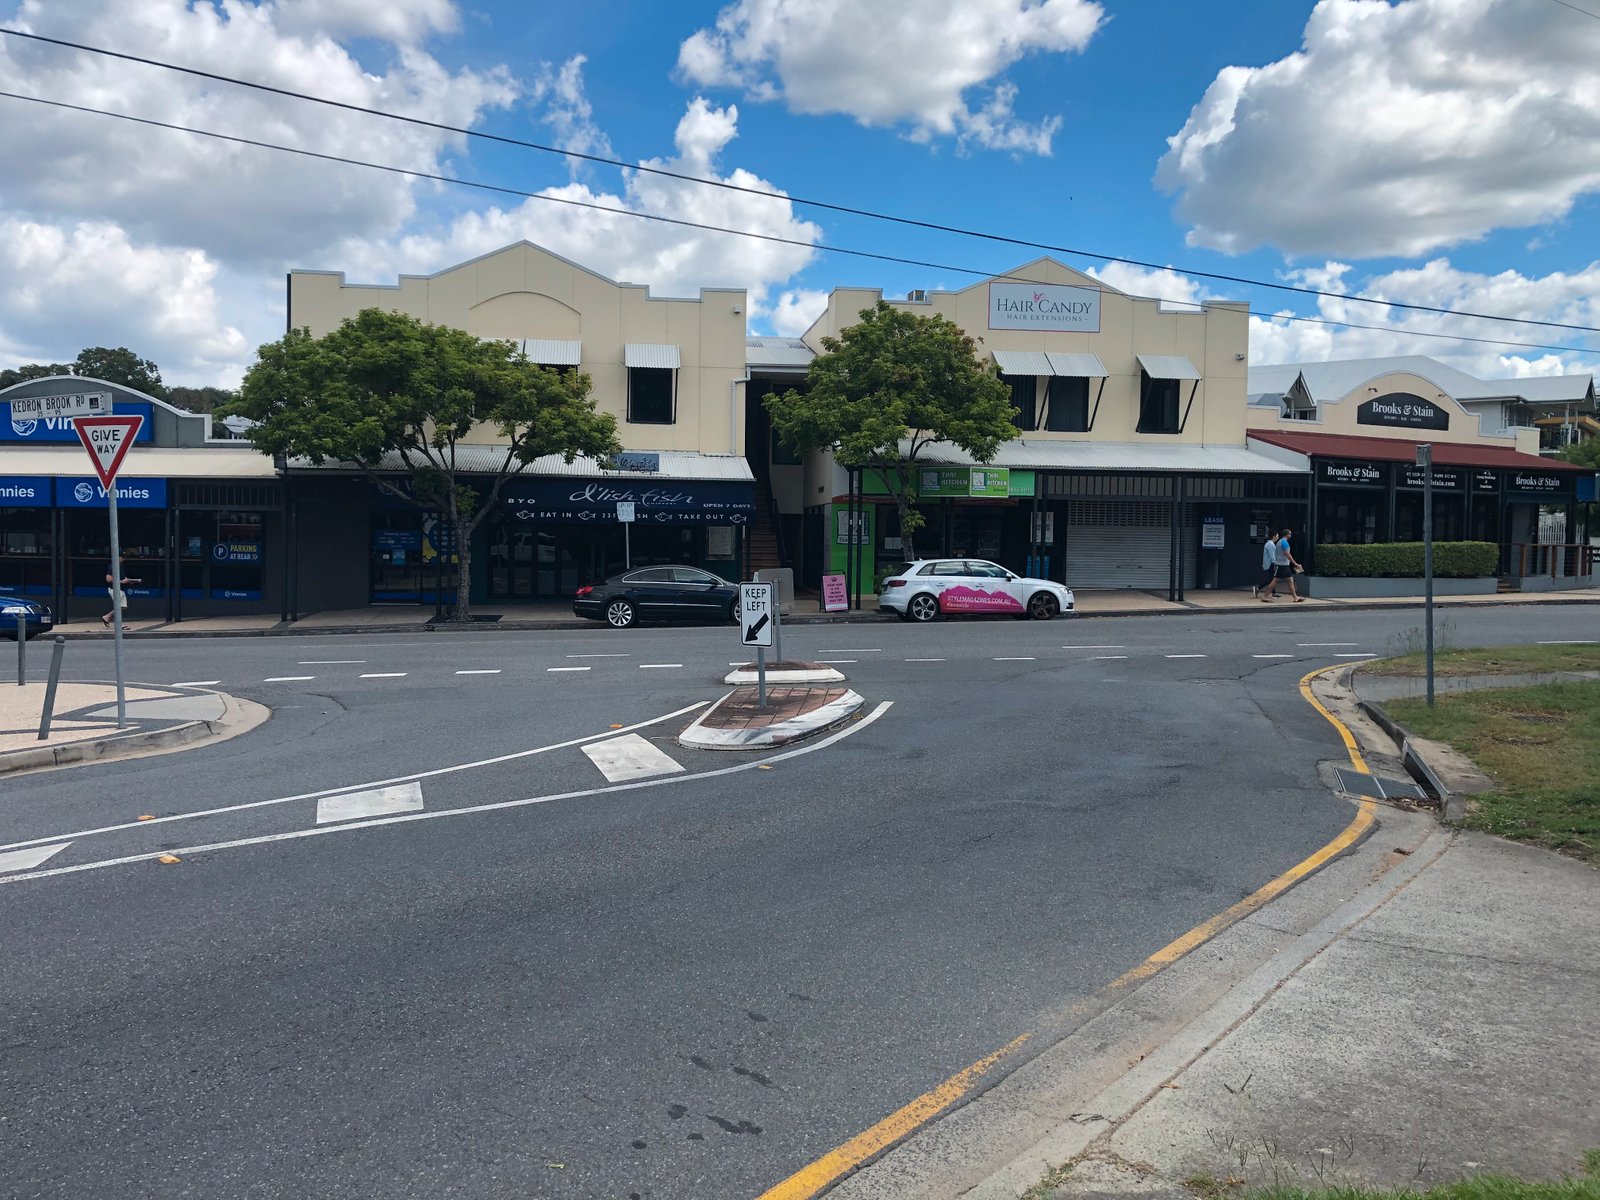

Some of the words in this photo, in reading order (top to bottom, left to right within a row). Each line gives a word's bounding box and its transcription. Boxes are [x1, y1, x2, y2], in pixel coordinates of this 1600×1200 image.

[997, 298, 1034, 312] HAIR
[1038, 299, 1093, 314] CANDY
[1030, 314, 1082, 322] EXTENSIONS
[12, 400, 42, 413] KEDRON
[46, 397, 71, 410] BROOK
[1372, 401, 1402, 415] Brooks
[1403, 405, 1411, 415] &
[1412, 405, 1434, 417] Stain
[91, 429, 121, 442] GIVE
[96, 444, 116, 454] WAY
[1327, 466, 1353, 477] Brooks
[1353, 467, 1361, 477] &
[1361, 468, 1380, 479] Stain
[1515, 476, 1537, 486] Brooks
[1537, 477, 1544, 486] &
[1544, 477, 1560, 487] Stain
[540, 511, 558, 519] EAT
[230, 544, 257, 552] PARKING
[745, 588, 767, 598] KEEP
[746, 601, 766, 611] LEFT
